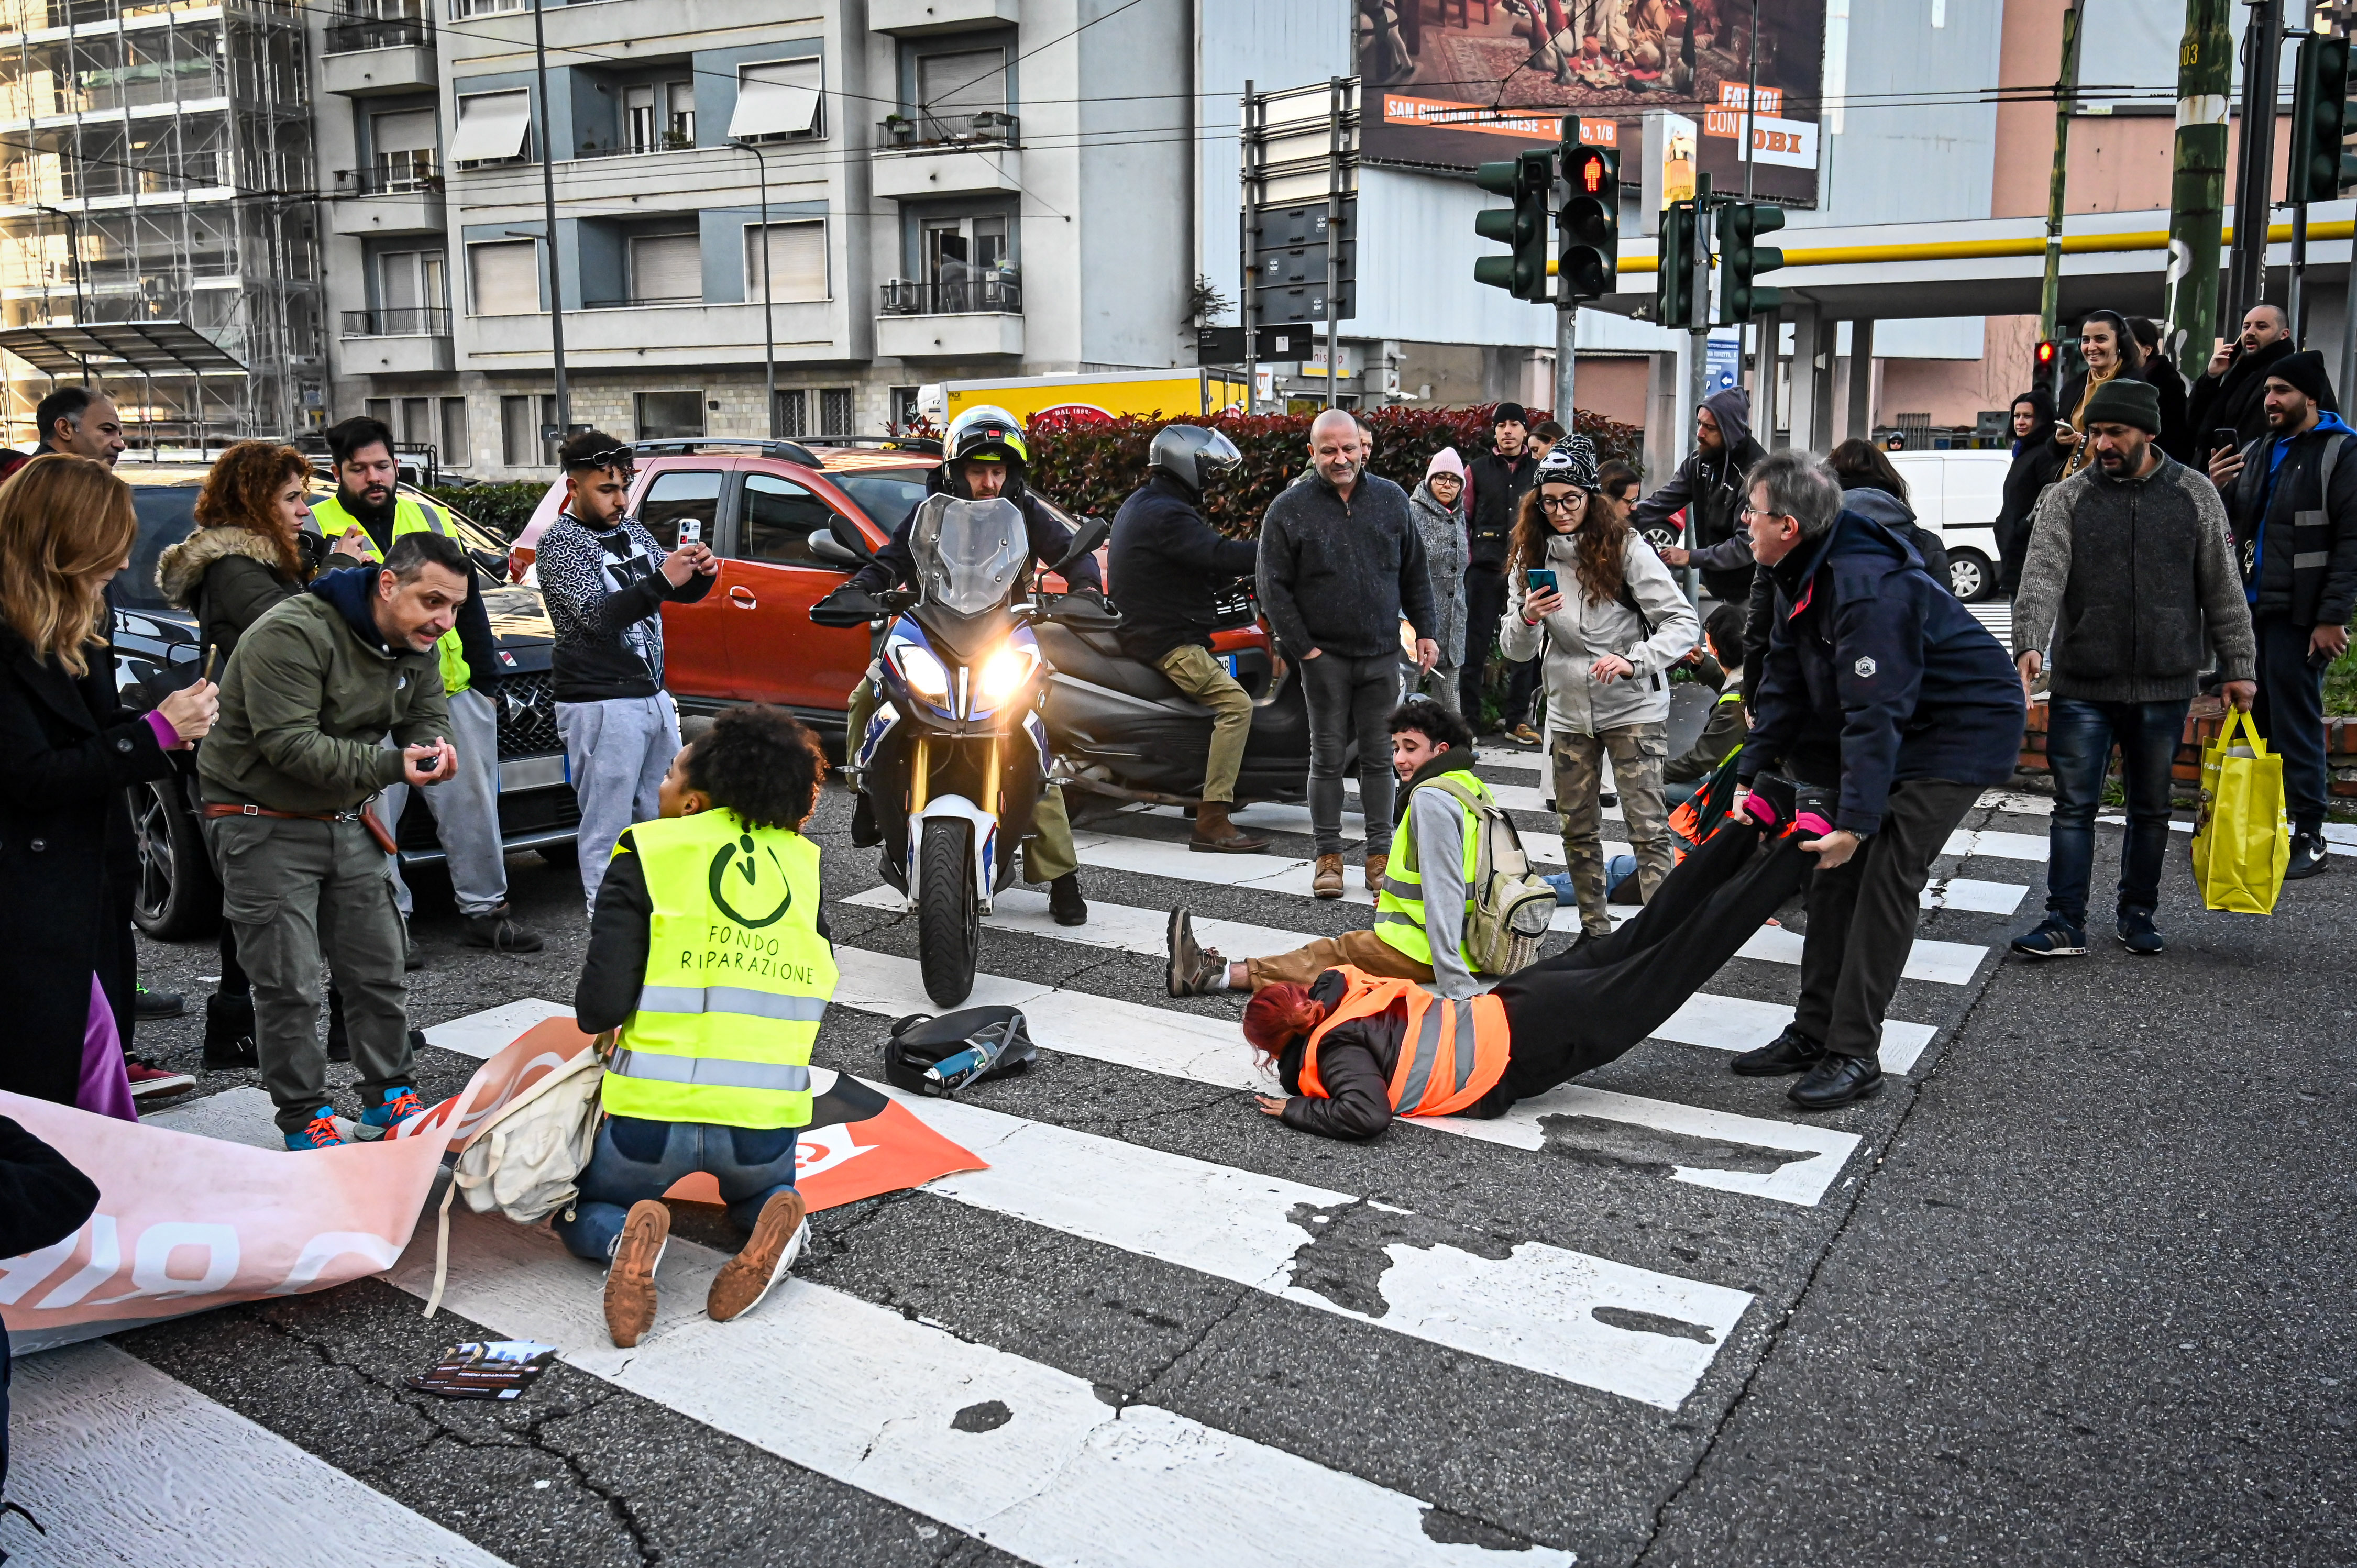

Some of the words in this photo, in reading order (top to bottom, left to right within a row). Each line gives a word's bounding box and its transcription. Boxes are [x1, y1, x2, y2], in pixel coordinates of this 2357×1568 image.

[1722, 85, 1779, 114] FATTO!
[1389, 100, 1414, 119] SAN
[1418, 103, 1475, 126] GIULIANO
[1479, 110, 1538, 133] MILANESE
[1596, 125, 1614, 141] 1/B
[1708, 109, 1737, 134] CON
[1753, 129, 1802, 154] OBI
[709, 925, 779, 956] FONDO
[681, 951, 813, 985] RIPARAZIONE
